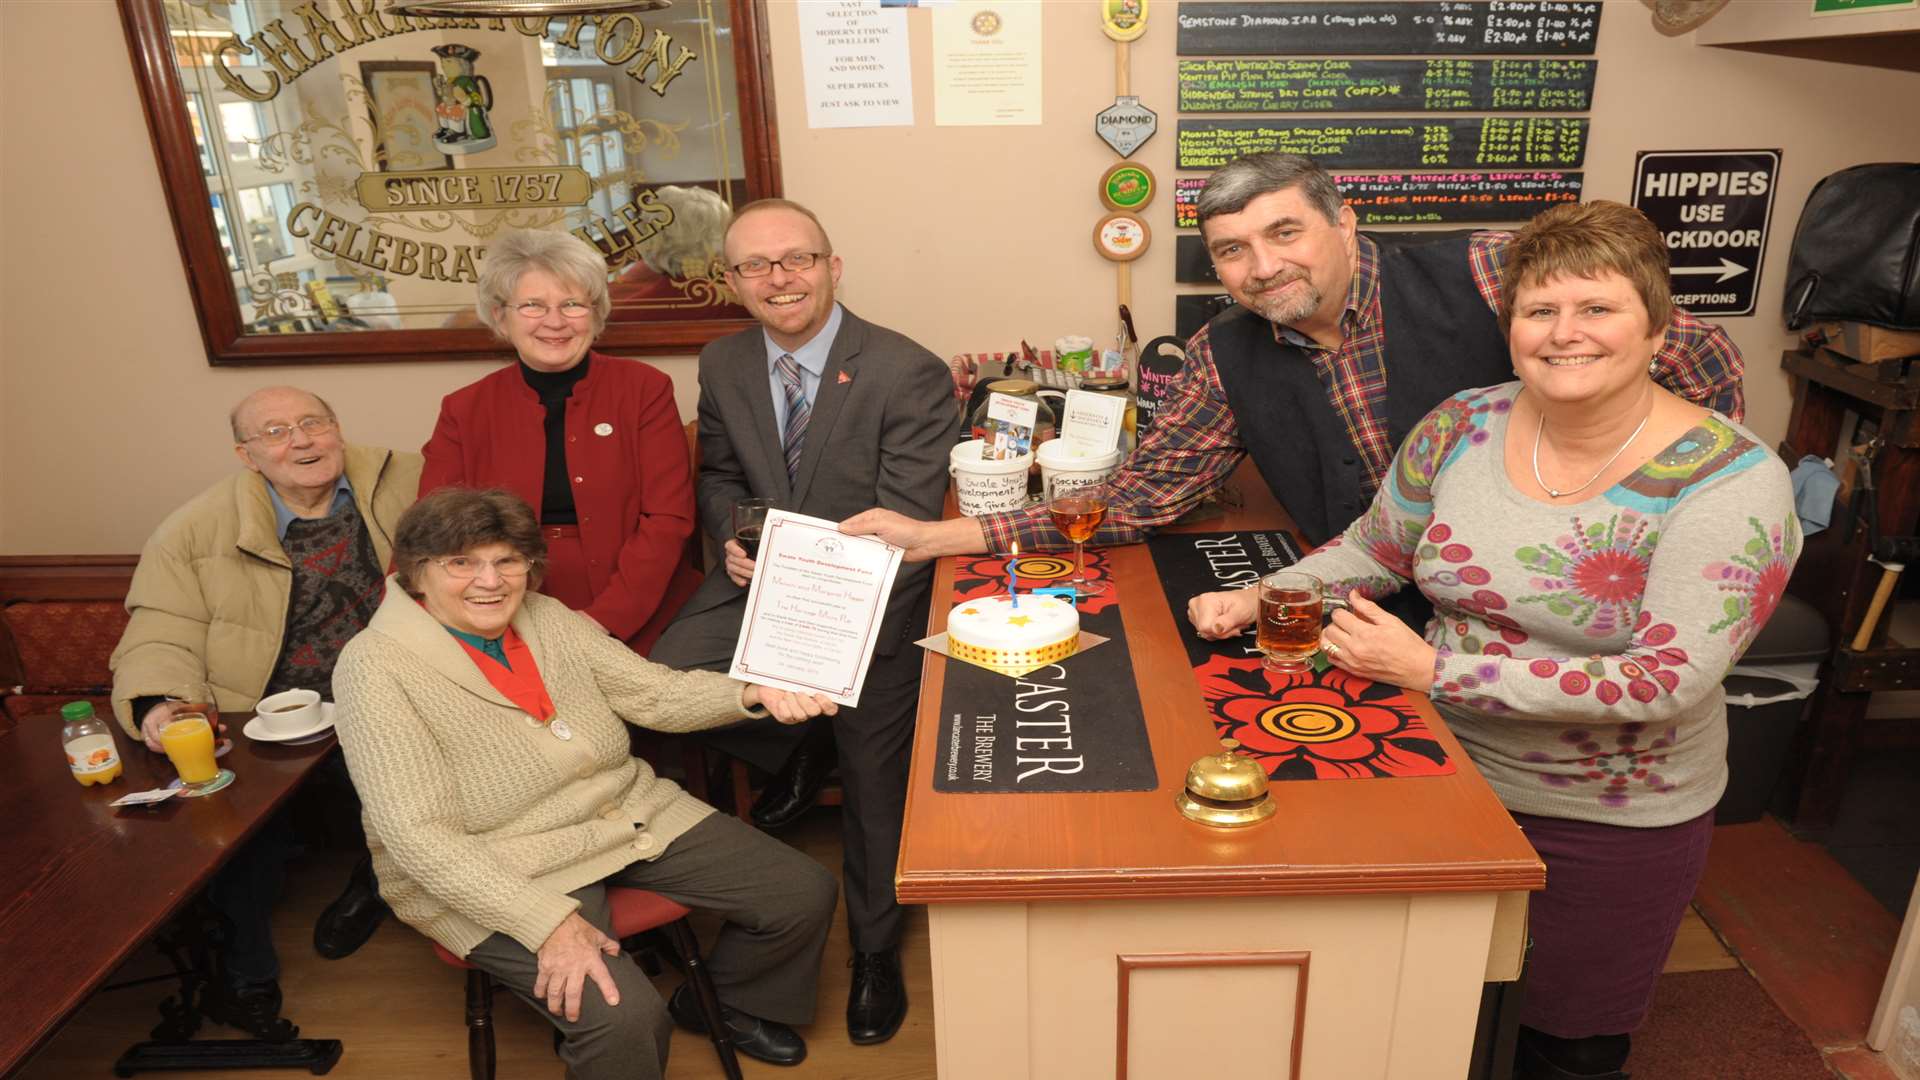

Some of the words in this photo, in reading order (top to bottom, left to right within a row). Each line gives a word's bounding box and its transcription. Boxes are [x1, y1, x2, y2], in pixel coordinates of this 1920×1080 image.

[826, 9, 877, 18] SELECTION
[846, 19, 859, 27] OF
[1178, 14, 1237, 28] GEMSTONE
[1241, 14, 1289, 27] DIAMOND
[816, 28, 855, 36] MODERN
[827, 37, 881, 45] JEWELLERY
[213, 0, 697, 102] CHARGTON
[829, 65, 848, 73] AND
[849, 63, 885, 72] WOMEN
[827, 82, 855, 90] SUPER
[857, 81, 889, 89] PRICES
[1302, 88, 1338, 97] CIDER
[820, 100, 841, 108] JUST
[863, 99, 876, 107] TO
[877, 98, 900, 107] VIEW
[1101, 115, 1152, 125] DIAMOND
[1324, 127, 1354, 135] CIDER
[1317, 135, 1349, 144] CIDER
[1179, 147, 1237, 156] HENDERSON
[1310, 145, 1343, 155] CIDER
[385, 175, 482, 206] SINCE
[491, 173, 563, 204] 1757
[1644, 171, 1769, 198] HIPPIES
[1679, 204, 1726, 223] USE
[286, 202, 488, 283] CELEBRA
[1659, 229, 1761, 248] CKDOOR
[1670, 293, 1737, 305] XCEPTIONS
[1139, 364, 1172, 385] WINTE
[959, 486, 1014, 499] evelopment
[984, 500, 1006, 511] Give
[975, 713, 997, 733] THE
[1015, 663, 1084, 783] CASTER
[972, 735, 996, 783] BREWERY
